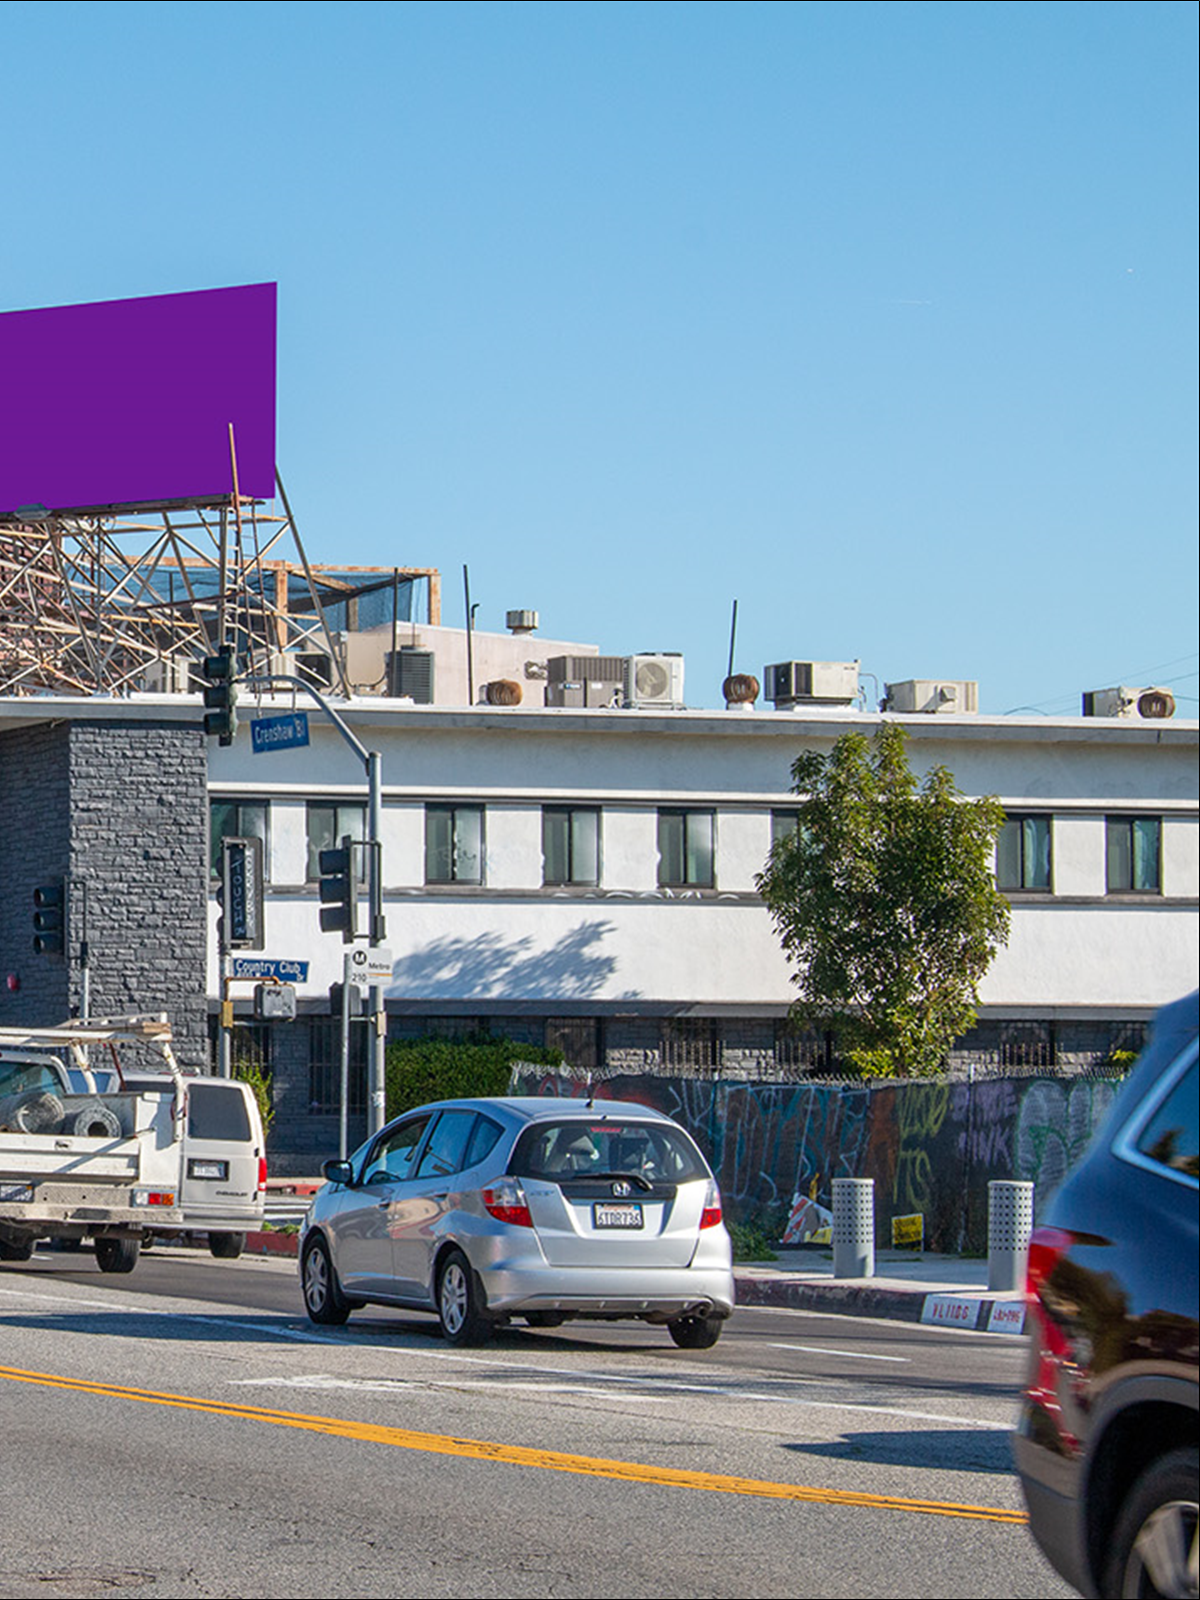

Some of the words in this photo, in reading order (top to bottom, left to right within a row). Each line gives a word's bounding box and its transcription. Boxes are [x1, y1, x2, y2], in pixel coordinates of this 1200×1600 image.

[255, 724, 293, 744] Crenshaw
[236, 959, 276, 975] Country
[279, 961, 301, 974] Club
[352, 973, 367, 982] 210
